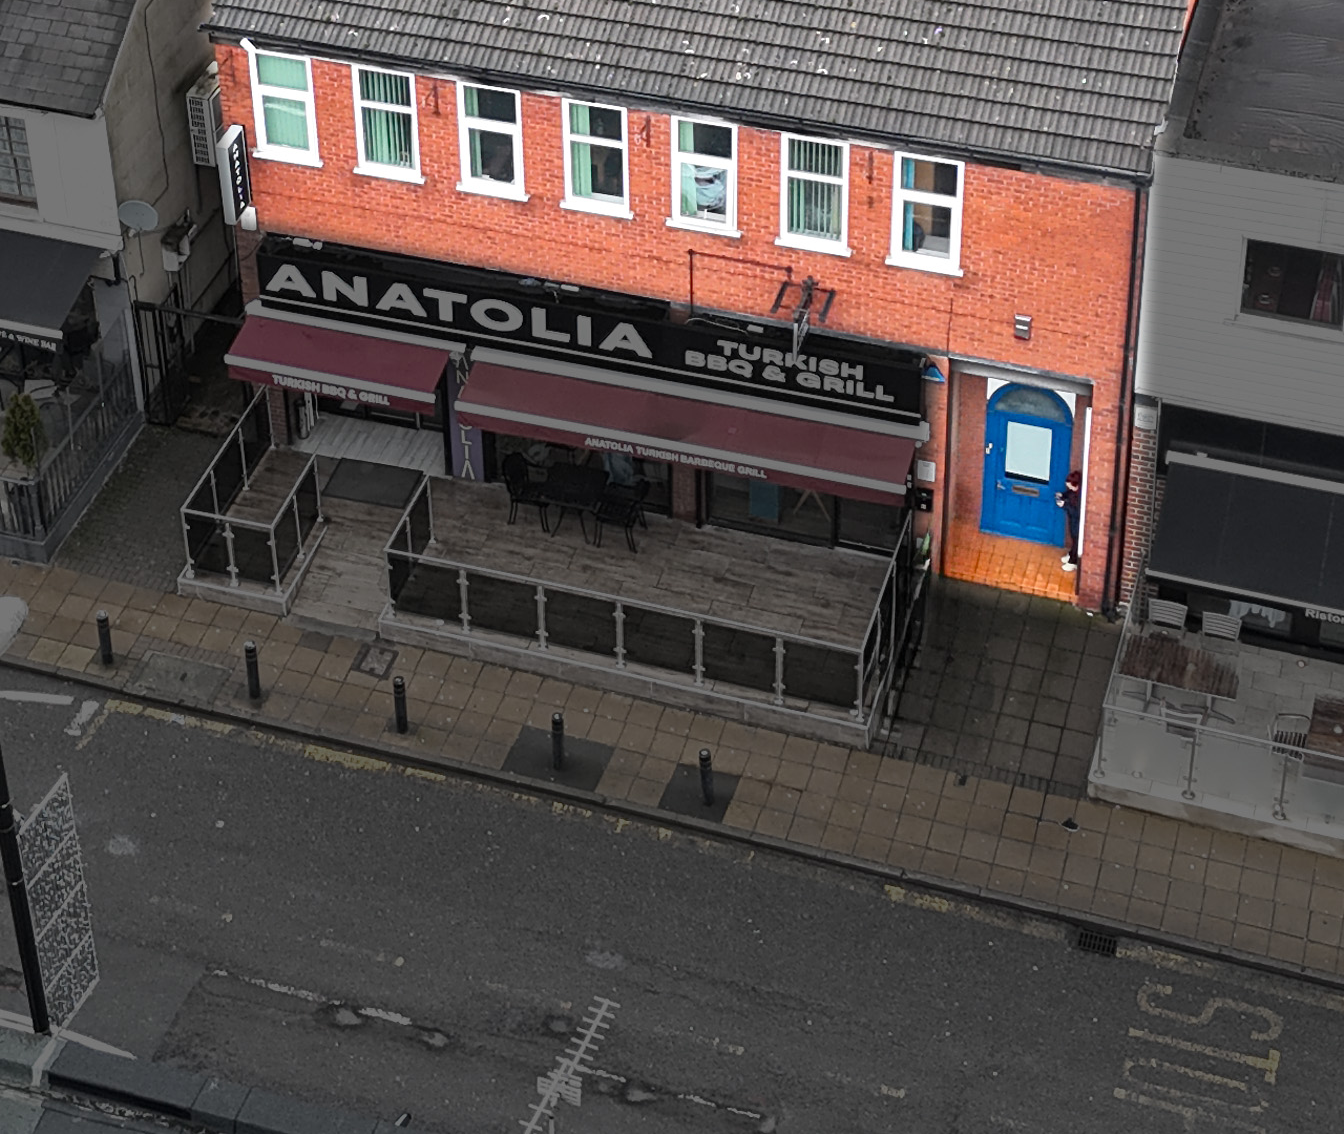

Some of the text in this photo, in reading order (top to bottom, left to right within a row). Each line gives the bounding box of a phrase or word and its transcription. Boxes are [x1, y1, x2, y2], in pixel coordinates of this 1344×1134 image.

[265, 263, 653, 359] ANATOLIA
[684, 349, 895, 403] BBQ & GRILL
[716, 339, 864, 381] TURKISH
[272, 374, 390, 406] TURKISH BBQ & GRILL
[585, 437, 768, 479] ANATOLIA TURKISH BARBEQUE GRILL
